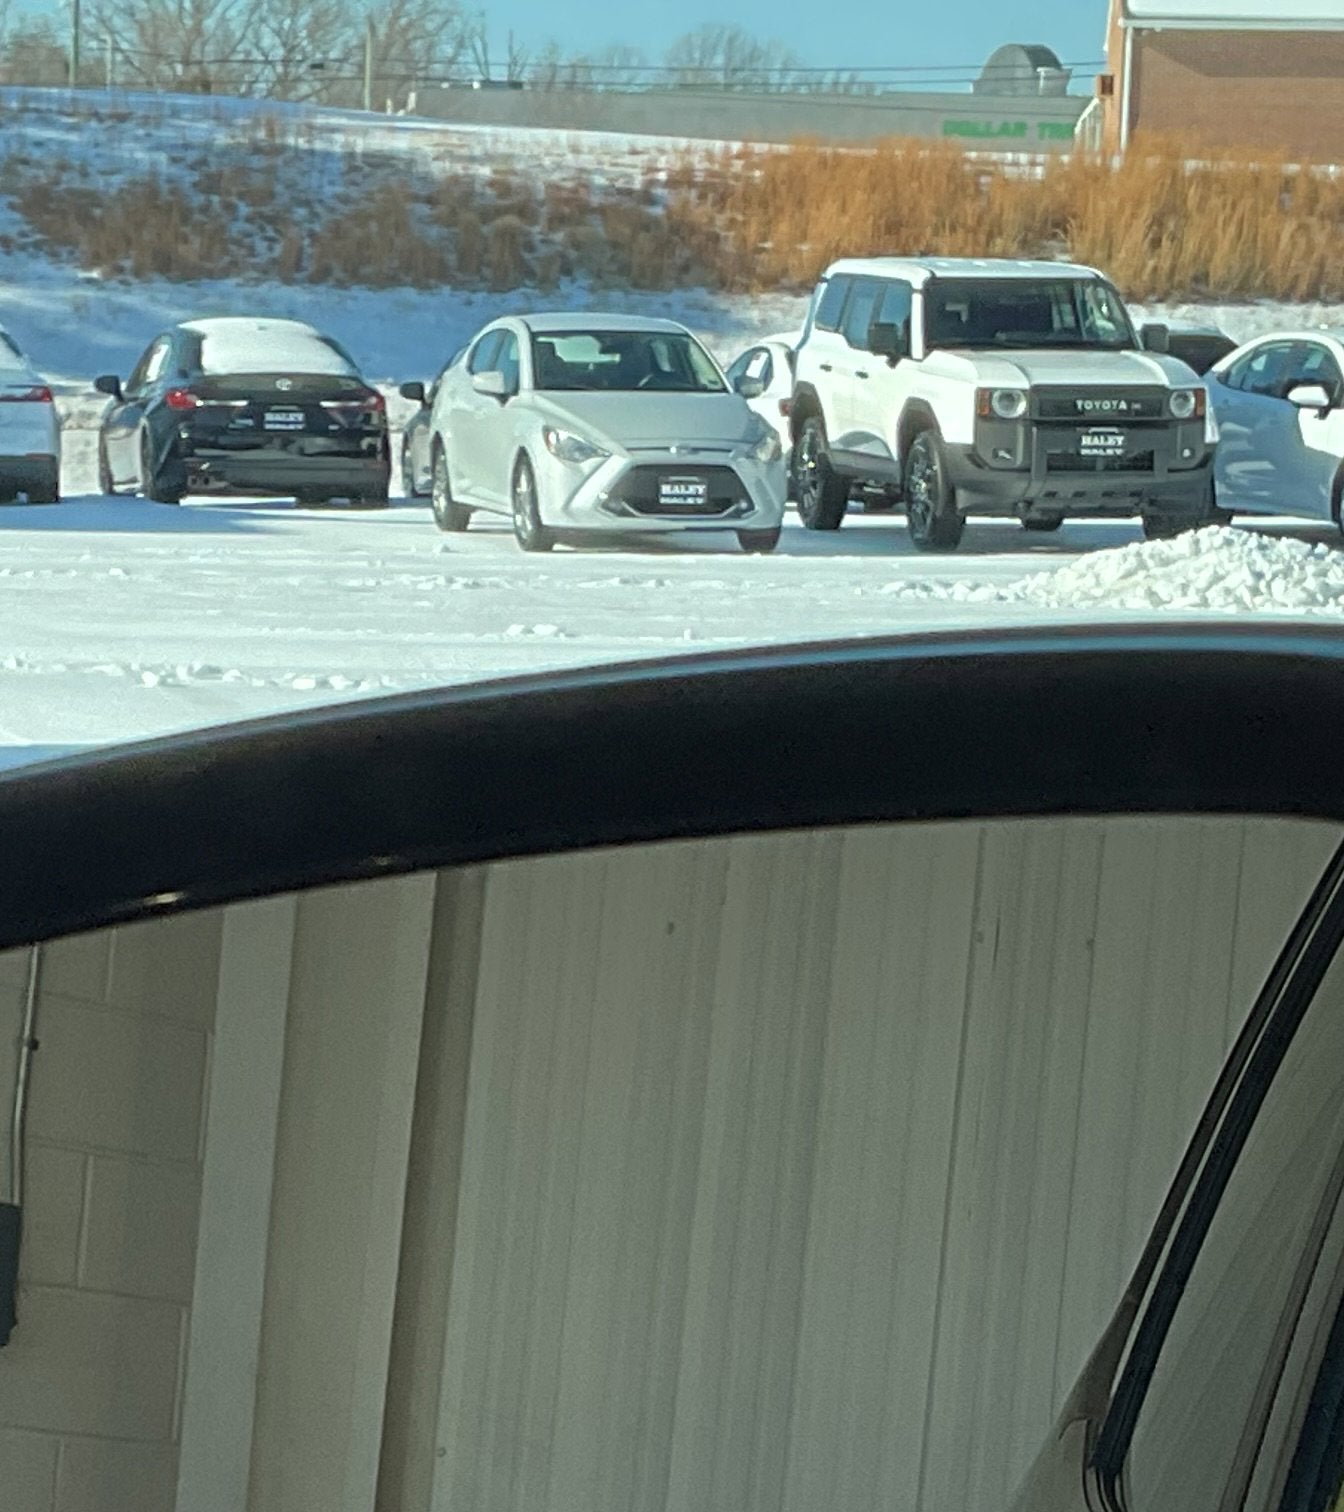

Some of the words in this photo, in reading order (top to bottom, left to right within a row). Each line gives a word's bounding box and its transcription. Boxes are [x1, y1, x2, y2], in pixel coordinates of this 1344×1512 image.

[1076, 400, 1127, 410] TOYOTA
[1081, 435, 1124, 446] HALEY
[661, 484, 706, 495] HALEY
